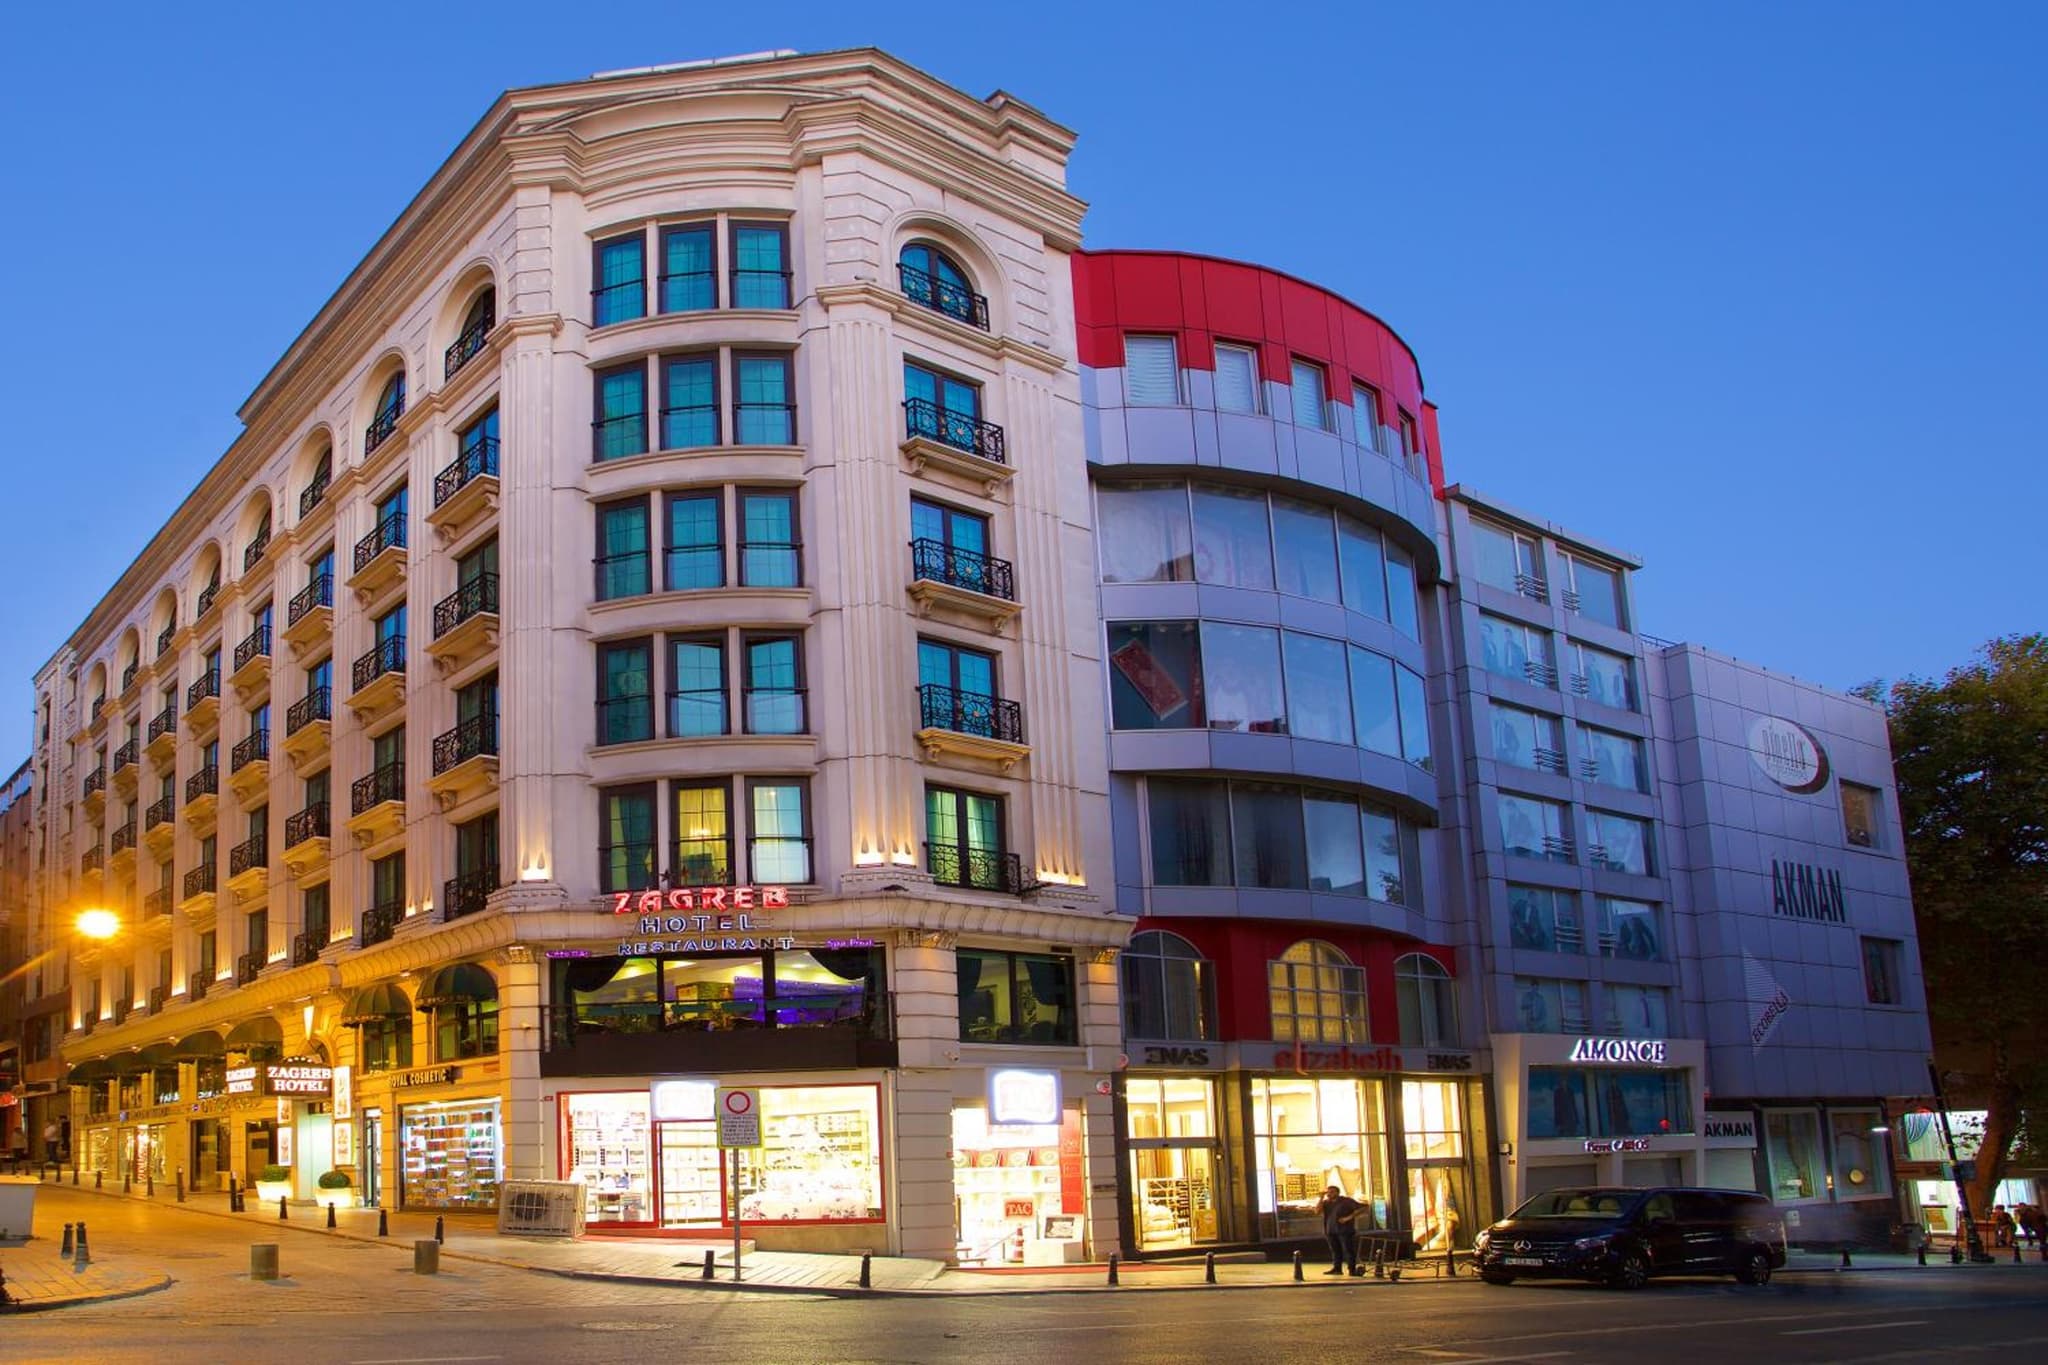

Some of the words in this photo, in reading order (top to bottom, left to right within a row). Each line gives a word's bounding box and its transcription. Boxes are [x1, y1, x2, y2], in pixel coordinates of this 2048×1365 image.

[614, 886, 789, 914] ZAGREB
[1772, 859, 1846, 924] AKMAN
[640, 913, 760, 935] HOTEL
[617, 937, 795, 956] RESTAURANT
[1570, 1038, 1667, 1063] AMONCE
[267, 1066, 332, 1079] ZAGREB
[274, 1079, 328, 1092] HOTEL
[1704, 1122, 1753, 1138] AKMAN
[1007, 1203, 1033, 1217] TAC
